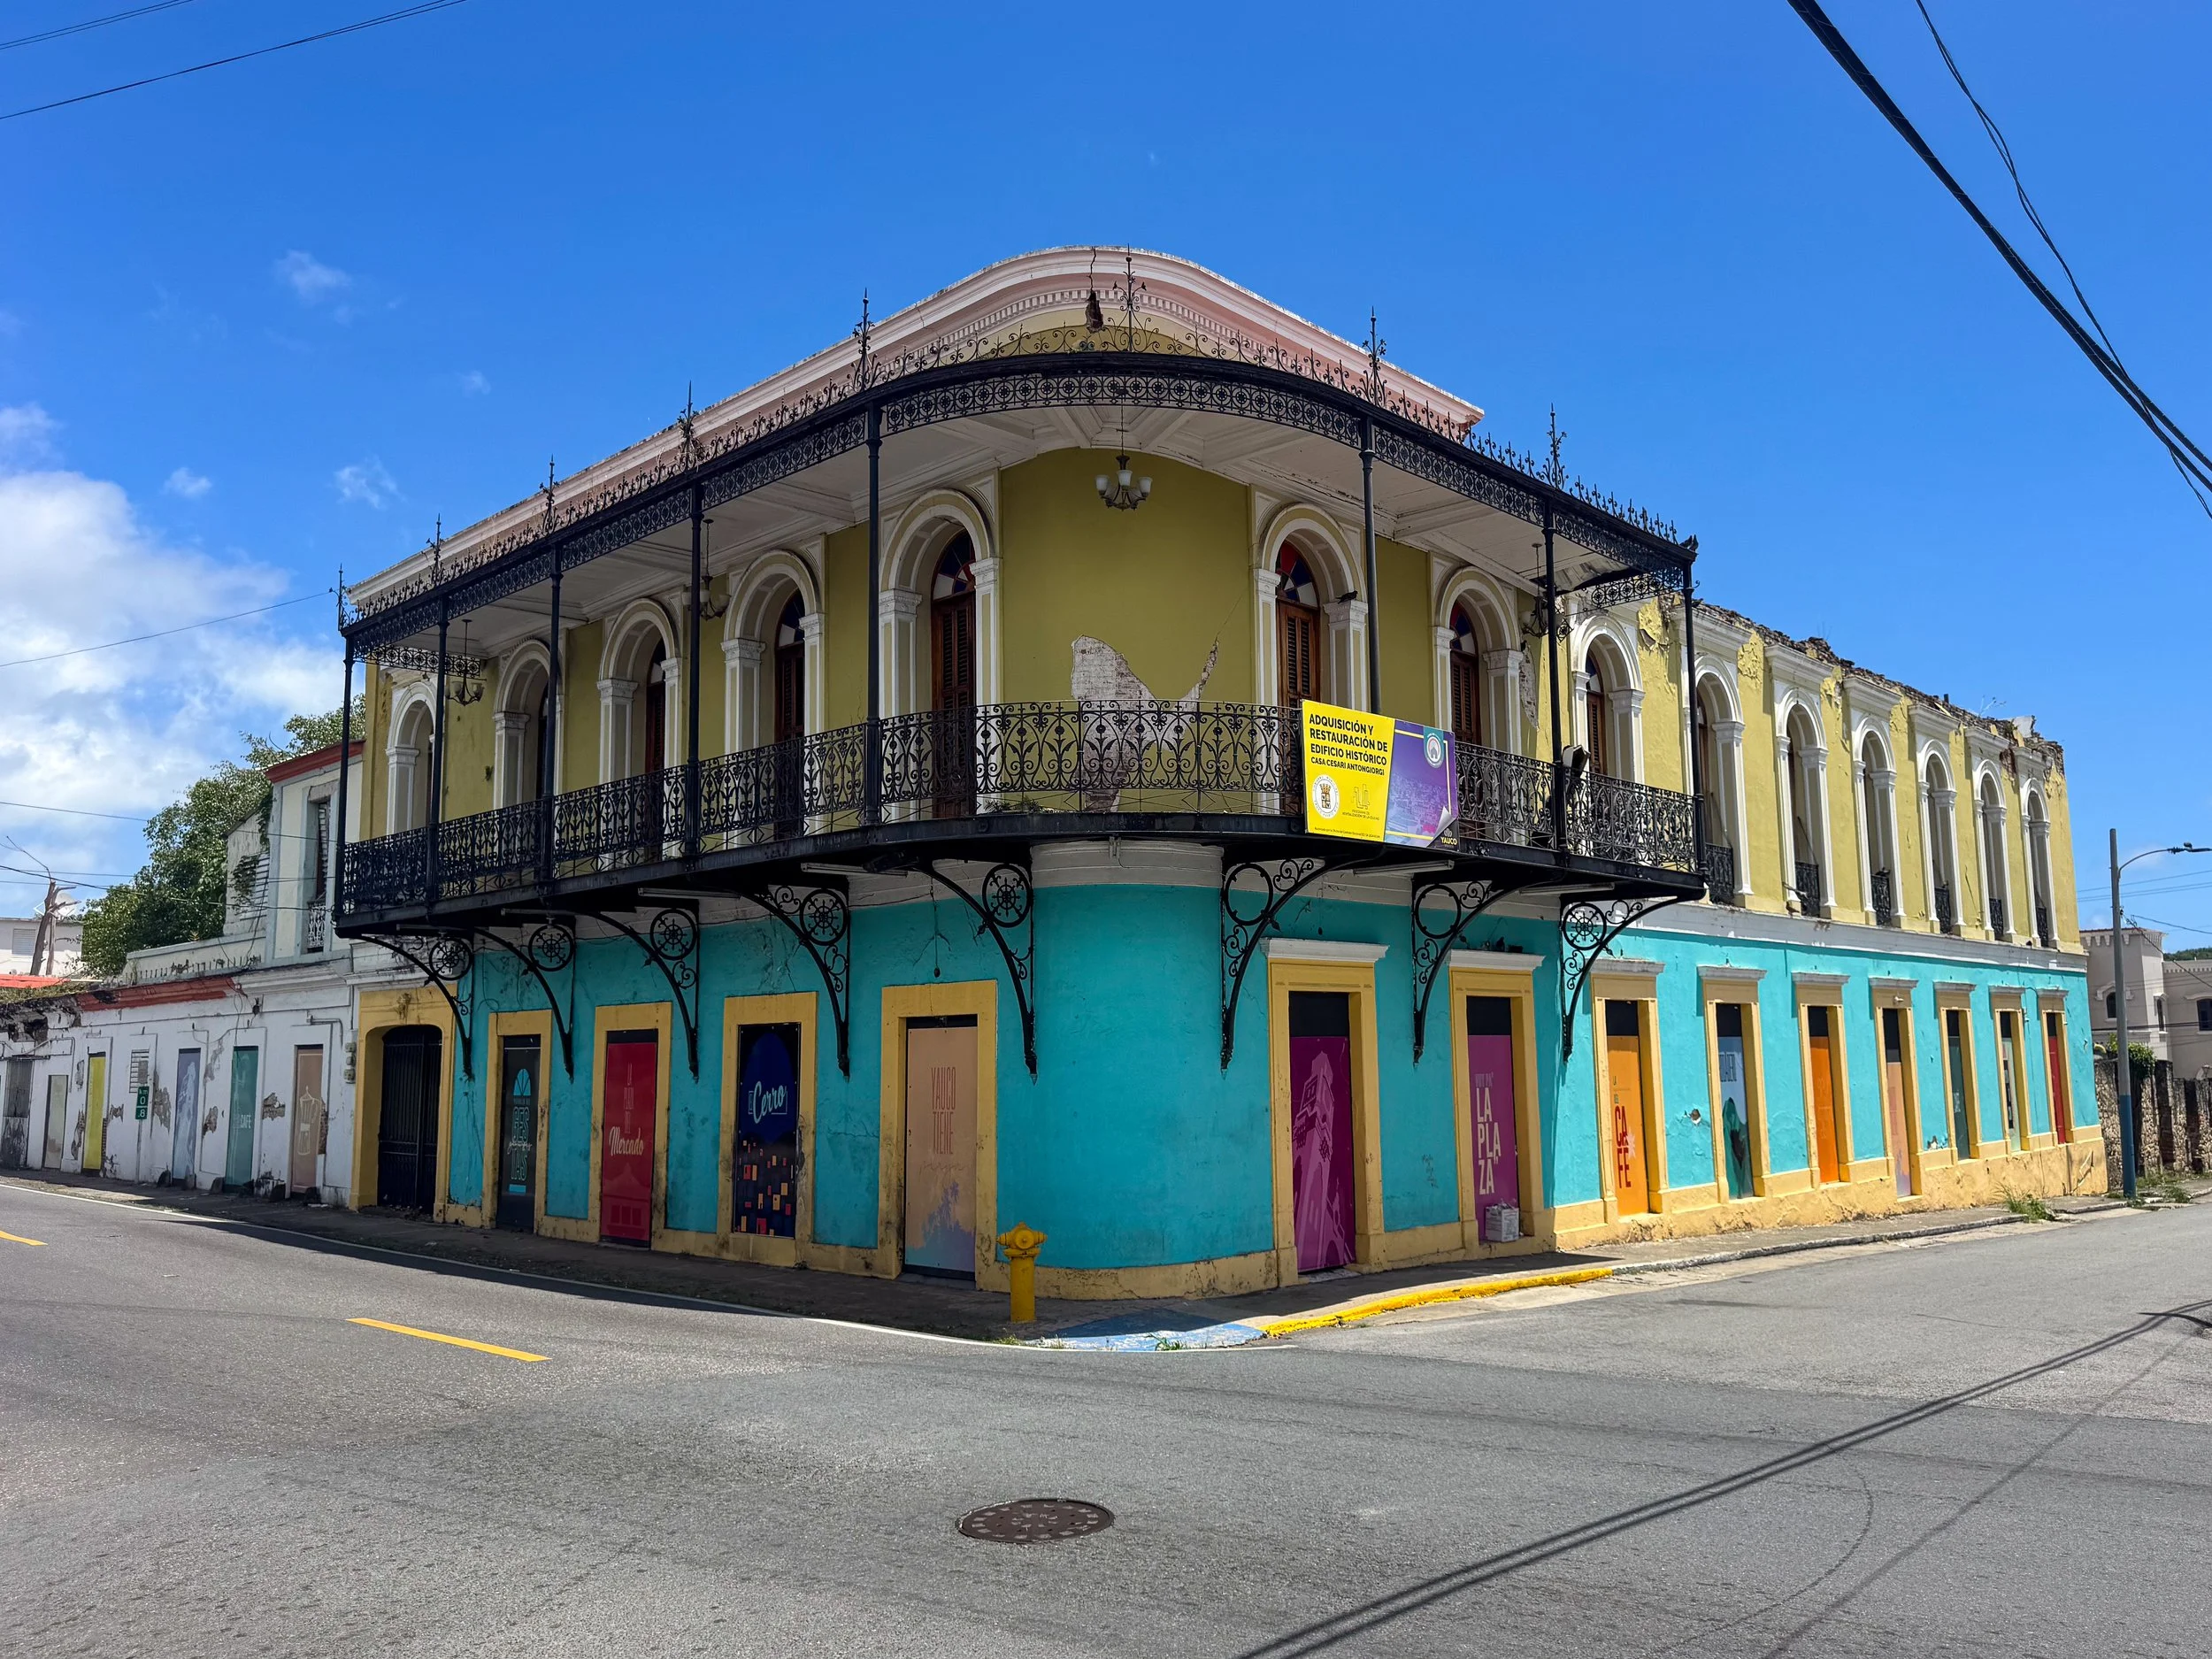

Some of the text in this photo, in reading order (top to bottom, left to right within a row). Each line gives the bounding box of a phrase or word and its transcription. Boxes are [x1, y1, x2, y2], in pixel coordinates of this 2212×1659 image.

[1310, 713, 1373, 735] ADQUISICIÓN Y
[1310, 728, 1387, 752] RESTAURACIÓN DE
[1310, 743, 1386, 765] EDIFICIO HISTÓRICO
[1311, 757, 1385, 775] CASA CESARI ANTONGIORGI
[931, 1066, 956, 1110] YAUCO
[753, 1080, 787, 1124] Cerro
[1476, 1087, 1492, 1123] LA
[609, 1125, 643, 1156] Mercado
